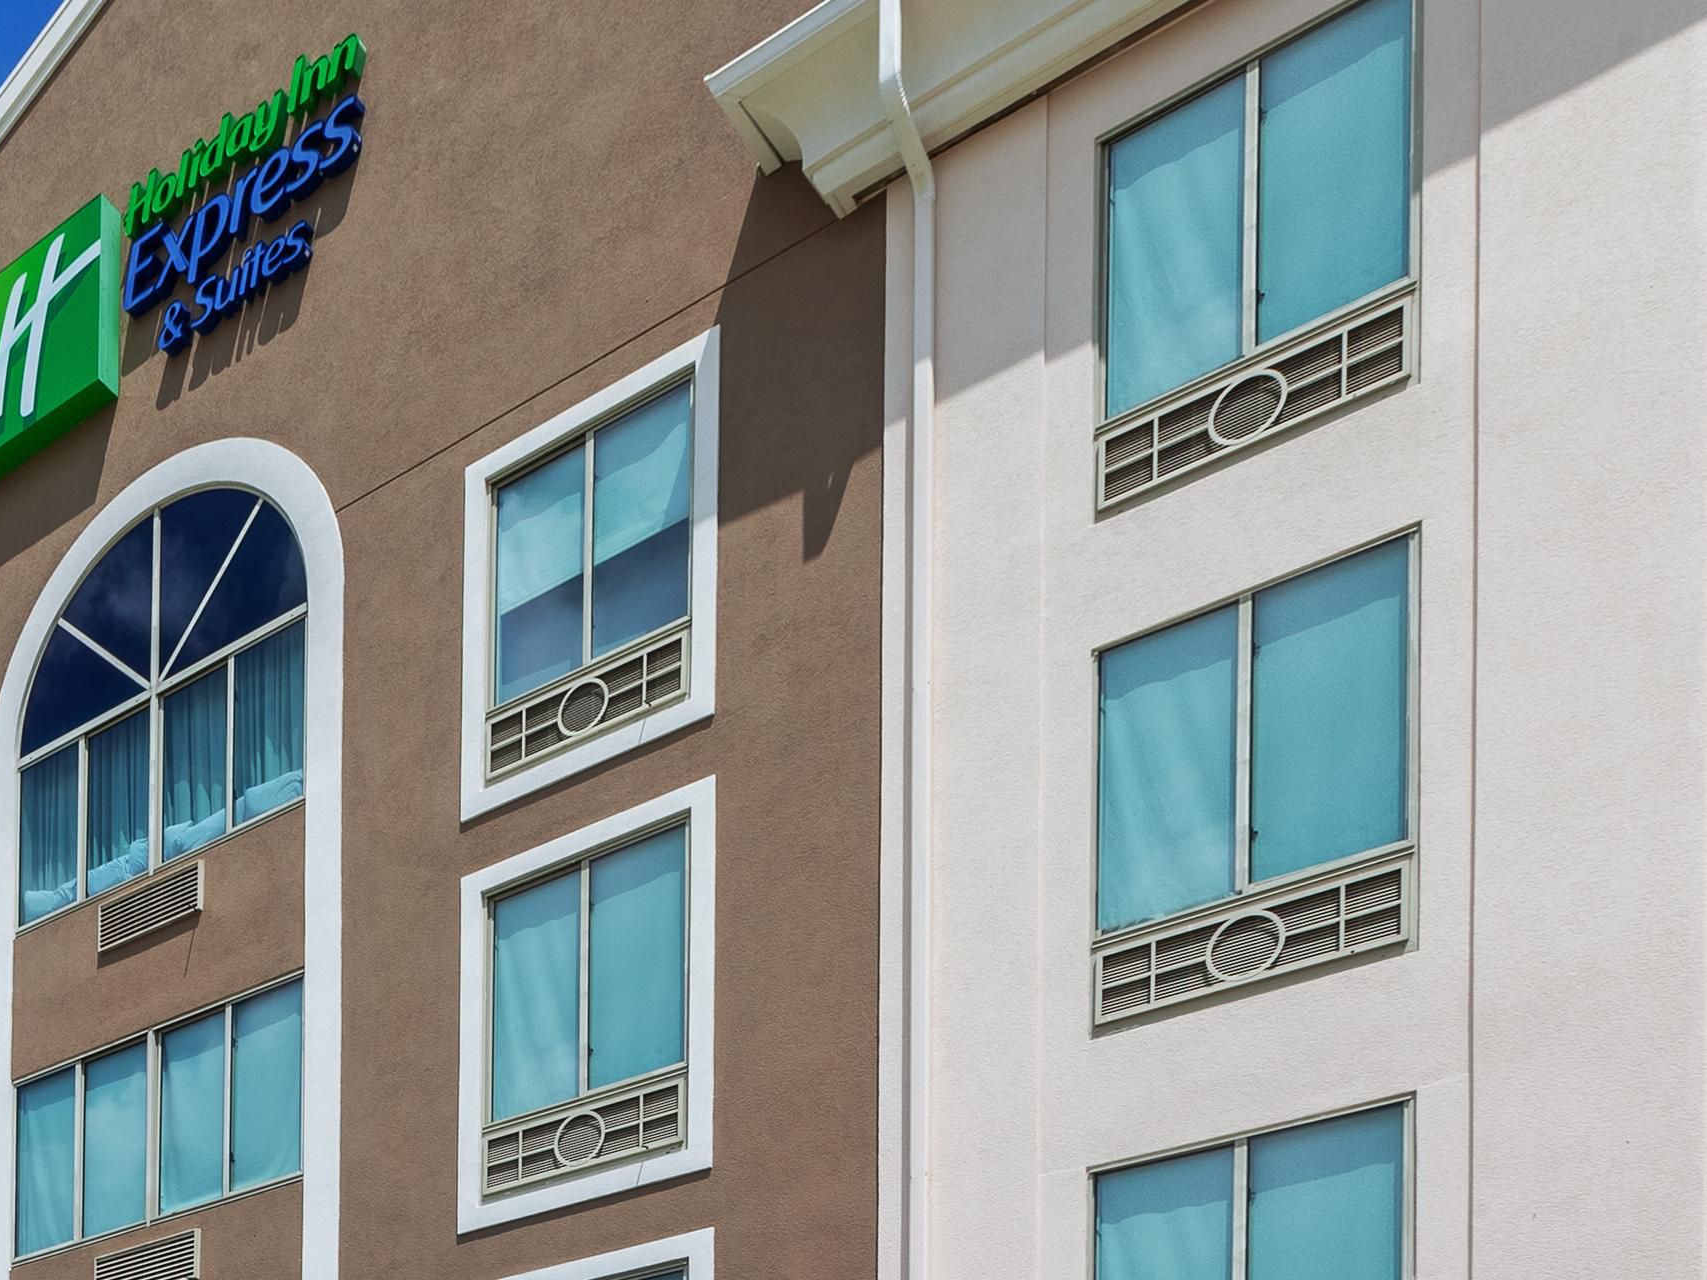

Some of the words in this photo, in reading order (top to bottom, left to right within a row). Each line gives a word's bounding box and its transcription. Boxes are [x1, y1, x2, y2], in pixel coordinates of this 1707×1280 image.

[124, 96, 364, 317] Express
[125, 90, 289, 238] Holiday
[288, 34, 365, 112] Inn
[159, 302, 192, 356] &
[191, 221, 313, 335] Suites
